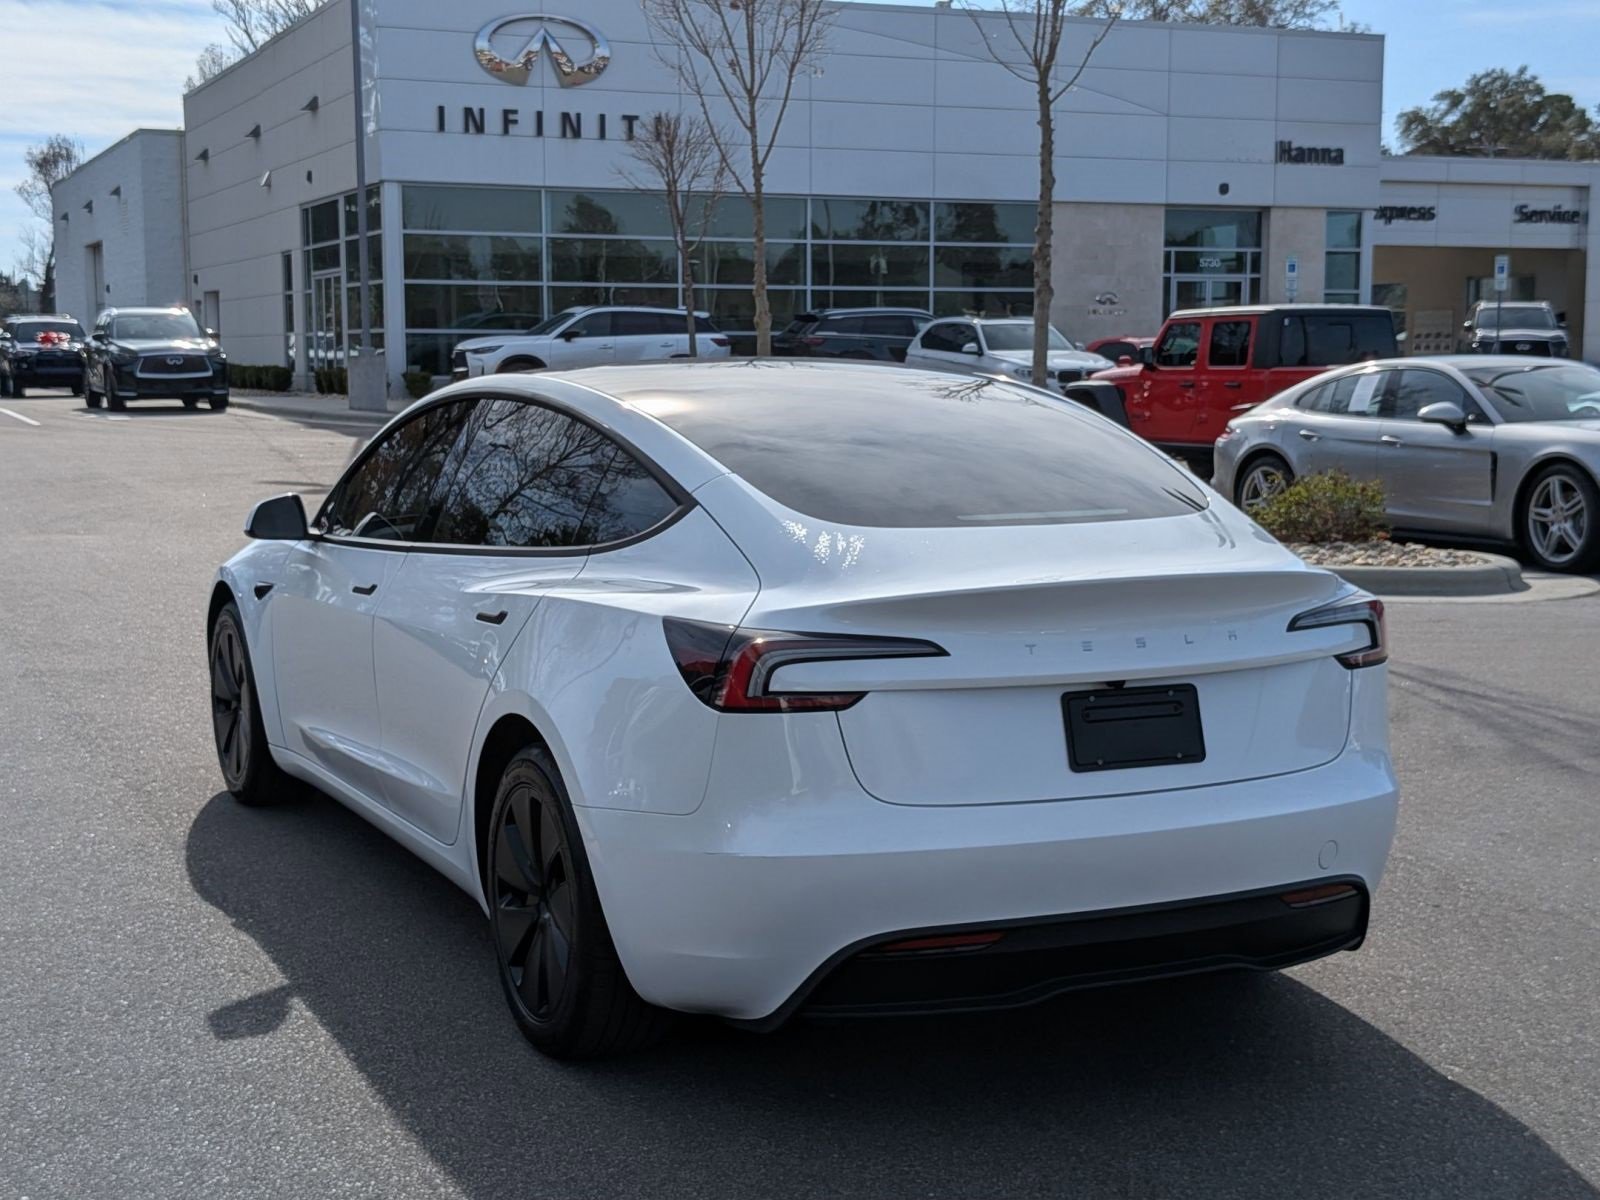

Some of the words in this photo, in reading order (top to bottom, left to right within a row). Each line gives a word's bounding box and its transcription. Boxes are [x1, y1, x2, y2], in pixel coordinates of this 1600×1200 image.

[1275, 141, 1344, 165] Hanna
[1374, 205, 1436, 225] xpress
[1513, 204, 1580, 223] Service
[1024, 630, 1238, 654] TESLA
